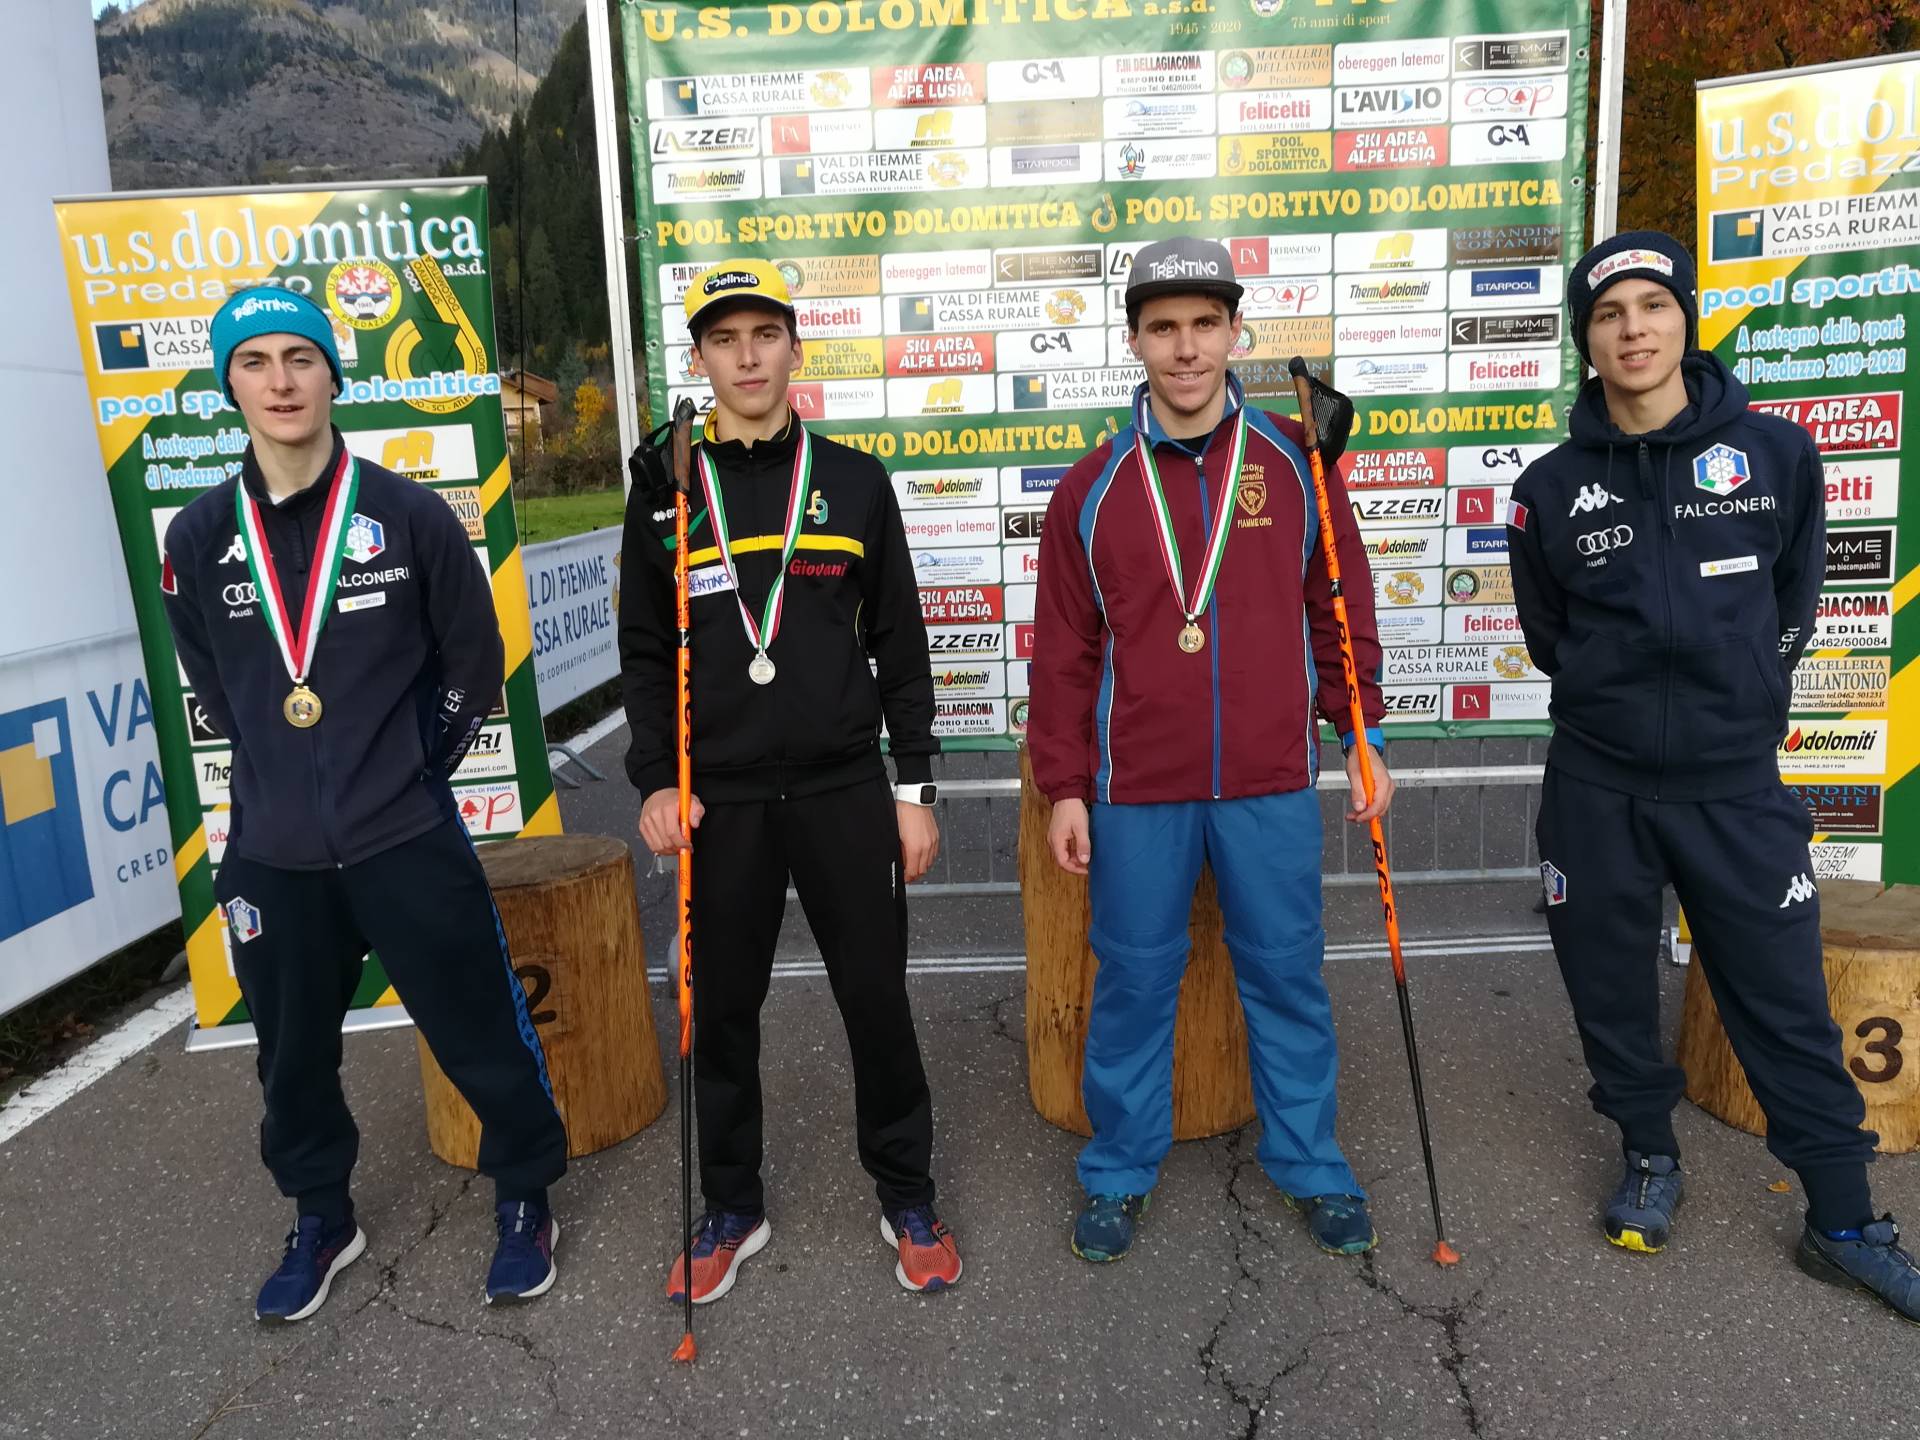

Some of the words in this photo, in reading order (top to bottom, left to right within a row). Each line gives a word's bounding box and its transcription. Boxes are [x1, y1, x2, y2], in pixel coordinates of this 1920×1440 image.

[641, 7, 748, 41] U.S.
[1310, 16, 1338, 27] anni
[1359, 13, 1390, 27] sport
[1169, 22, 1198, 35] 1945
[1210, 22, 1241, 33] 2020
[1257, 47, 1330, 60] MACELLERIA
[1490, 41, 1560, 54] FIEMME
[1134, 55, 1201, 73] DELLAGIACOMA
[1256, 61, 1329, 73] DELLANTONIO
[1339, 54, 1397, 71] obereggen
[1401, 51, 1444, 67] latemar
[701, 76, 729, 89] VAL
[751, 73, 805, 86] FIEMME
[894, 69, 921, 83] SKI
[923, 67, 966, 82] AREA
[1121, 76, 1166, 84] EMPORIO
[1169, 75, 1197, 83] EDILE
[1269, 75, 1314, 85] Predazzo
[703, 92, 750, 105] CASSA
[753, 89, 805, 102] RURALE
[887, 84, 924, 99] ALPE
[929, 82, 973, 98] LUSIA
[1240, 100, 1311, 121] felicetti
[653, 126, 755, 154] LAZZERI
[1272, 137, 1304, 147] POOL
[1356, 133, 1380, 148] SKI
[1384, 131, 1428, 147] AREA
[1257, 147, 1320, 159] SPORTIVO
[1347, 149, 1384, 164] ALPE
[1390, 146, 1435, 161] LUSIA
[819, 157, 845, 169] VAL
[849, 156, 863, 168] DI
[868, 153, 922, 166] FIEMME
[1017, 157, 1074, 168] STARPOOL
[1248, 158, 1327, 172] DOLOMITICA
[820, 171, 865, 184] CASSA
[870, 168, 923, 182] RURALE
[1126, 196, 1202, 224] POOL
[1209, 188, 1361, 221] SPORTIVO
[1368, 179, 1563, 214] DOLOMITICA
[1772, 204, 1812, 222] VAL
[1820, 201, 1840, 216] DI
[656, 220, 731, 247] POOL
[738, 211, 886, 244] SPORTIVO
[894, 201, 1082, 236] DOLOMITICA
[1453, 226, 1561, 240] MORANDINI
[1772, 222, 1841, 243] CASSA
[1772, 246, 1810, 255] CREDITO
[1814, 240, 1879, 251] COOPERATIVO
[443, 259, 486, 276] a.s.d.
[805, 258, 879, 270] MACELLERIA
[886, 265, 941, 281] obereggen
[946, 261, 987, 276] latemar
[1150, 258, 1218, 279] TRENTINO
[806, 270, 877, 281] DELLANTONIO
[819, 284, 864, 294] Predazzo
[1476, 281, 1535, 292] STARPOOL
[938, 294, 965, 306] VAL
[968, 293, 982, 304] DI
[987, 290, 1040, 304] FIEMME
[1702, 277, 1786, 317] pool
[232, 298, 298, 321] TRENTINO
[939, 308, 985, 322] CASSA
[988, 305, 1041, 320] RURALE
[150, 321, 185, 336] VAL
[1258, 320, 1330, 332] MACELLERIA
[1485, 318, 1553, 330] FIEMME
[1258, 332, 1330, 344] DELLANTONIO
[1339, 326, 1396, 343] obereggen
[1401, 325, 1442, 339] latemar
[1735, 325, 1750, 352] A
[1752, 324, 1820, 352] sostegno
[1821, 316, 1860, 345] dello
[1862, 314, 1905, 346] sport
[825, 342, 857, 353] POOL
[906, 339, 929, 353] SKI
[933, 336, 975, 352] AREA
[1271, 346, 1316, 355] Predazzo
[811, 352, 872, 366] SPORTIVO
[899, 353, 935, 369] ALPE
[940, 351, 983, 366] LUSIA
[1488, 352, 1521, 360] PASTA
[803, 364, 880, 377] DOLOMITICA
[1470, 360, 1539, 381] felicetti
[1733, 358, 1750, 384] di
[1751, 354, 1825, 384] Predazzo
[1826, 347, 1906, 378] 2019-2021
[1053, 371, 1079, 384] VAL
[1082, 369, 1097, 382] DI
[1053, 387, 1099, 400] CASSA
[1470, 382, 1515, 390] DOLOMITI
[98, 389, 176, 424] pool
[1806, 398, 1881, 424] AREA
[1369, 403, 1557, 436] DOLOMITICA
[1815, 420, 1895, 444] LUSIA
[143, 433, 155, 459] A
[155, 433, 215, 460] sostegno
[904, 424, 1085, 456] DOLOMITICA
[1828, 443, 1867, 451] MOENA
[1356, 453, 1380, 467] SKI
[1384, 451, 1427, 466] AREA
[1706, 448, 1734, 462] FISI
[145, 464, 160, 491] di
[160, 462, 227, 489] Predazzo
[1348, 469, 1384, 483] ALPE
[1389, 466, 1434, 481] LUSIA
[1675, 496, 1776, 519] FALCONERI
[1838, 507, 1872, 517] 1908
[956, 520, 996, 532] latemar
[1237, 518, 1259, 528] FIAMME
[1260, 517, 1272, 526] ORO
[790, 560, 847, 577] Giovani
[1586, 556, 1607, 568] Audi
[1720, 561, 1753, 571] ESERCITO
[1837, 561, 1881, 573] biocompatibili
[541, 565, 556, 606] DI
[560, 555, 607, 599] FIEMME
[919, 591, 941, 604] SKI
[945, 589, 985, 603] AREA
[229, 607, 254, 619] Audi
[950, 603, 992, 617] LUSIA
[563, 597, 610, 645] RURALE
[1826, 624, 1879, 634] EDILE
[1812, 637, 1888, 648] 0462/500084
[1389, 649, 1415, 660] VAL
[1418, 649, 1431, 659] DI
[1436, 646, 1488, 659] FIEMME
[547, 652, 587, 683] COOPERATIVO
[588, 640, 612, 661] ITALIANO
[1389, 662, 1431, 675] CASSA
[1436, 661, 1488, 672] RURALE
[1795, 659, 1885, 671] MACELLERIA
[1793, 691, 1826, 699] Predazzo
[1857, 691, 1883, 699] 501231
[1810, 846, 1859, 859] SISTEMI
[1816, 860, 1847, 872] IDRO
[513, 965, 557, 1025] 2
[1850, 1016, 1903, 1083] 3
